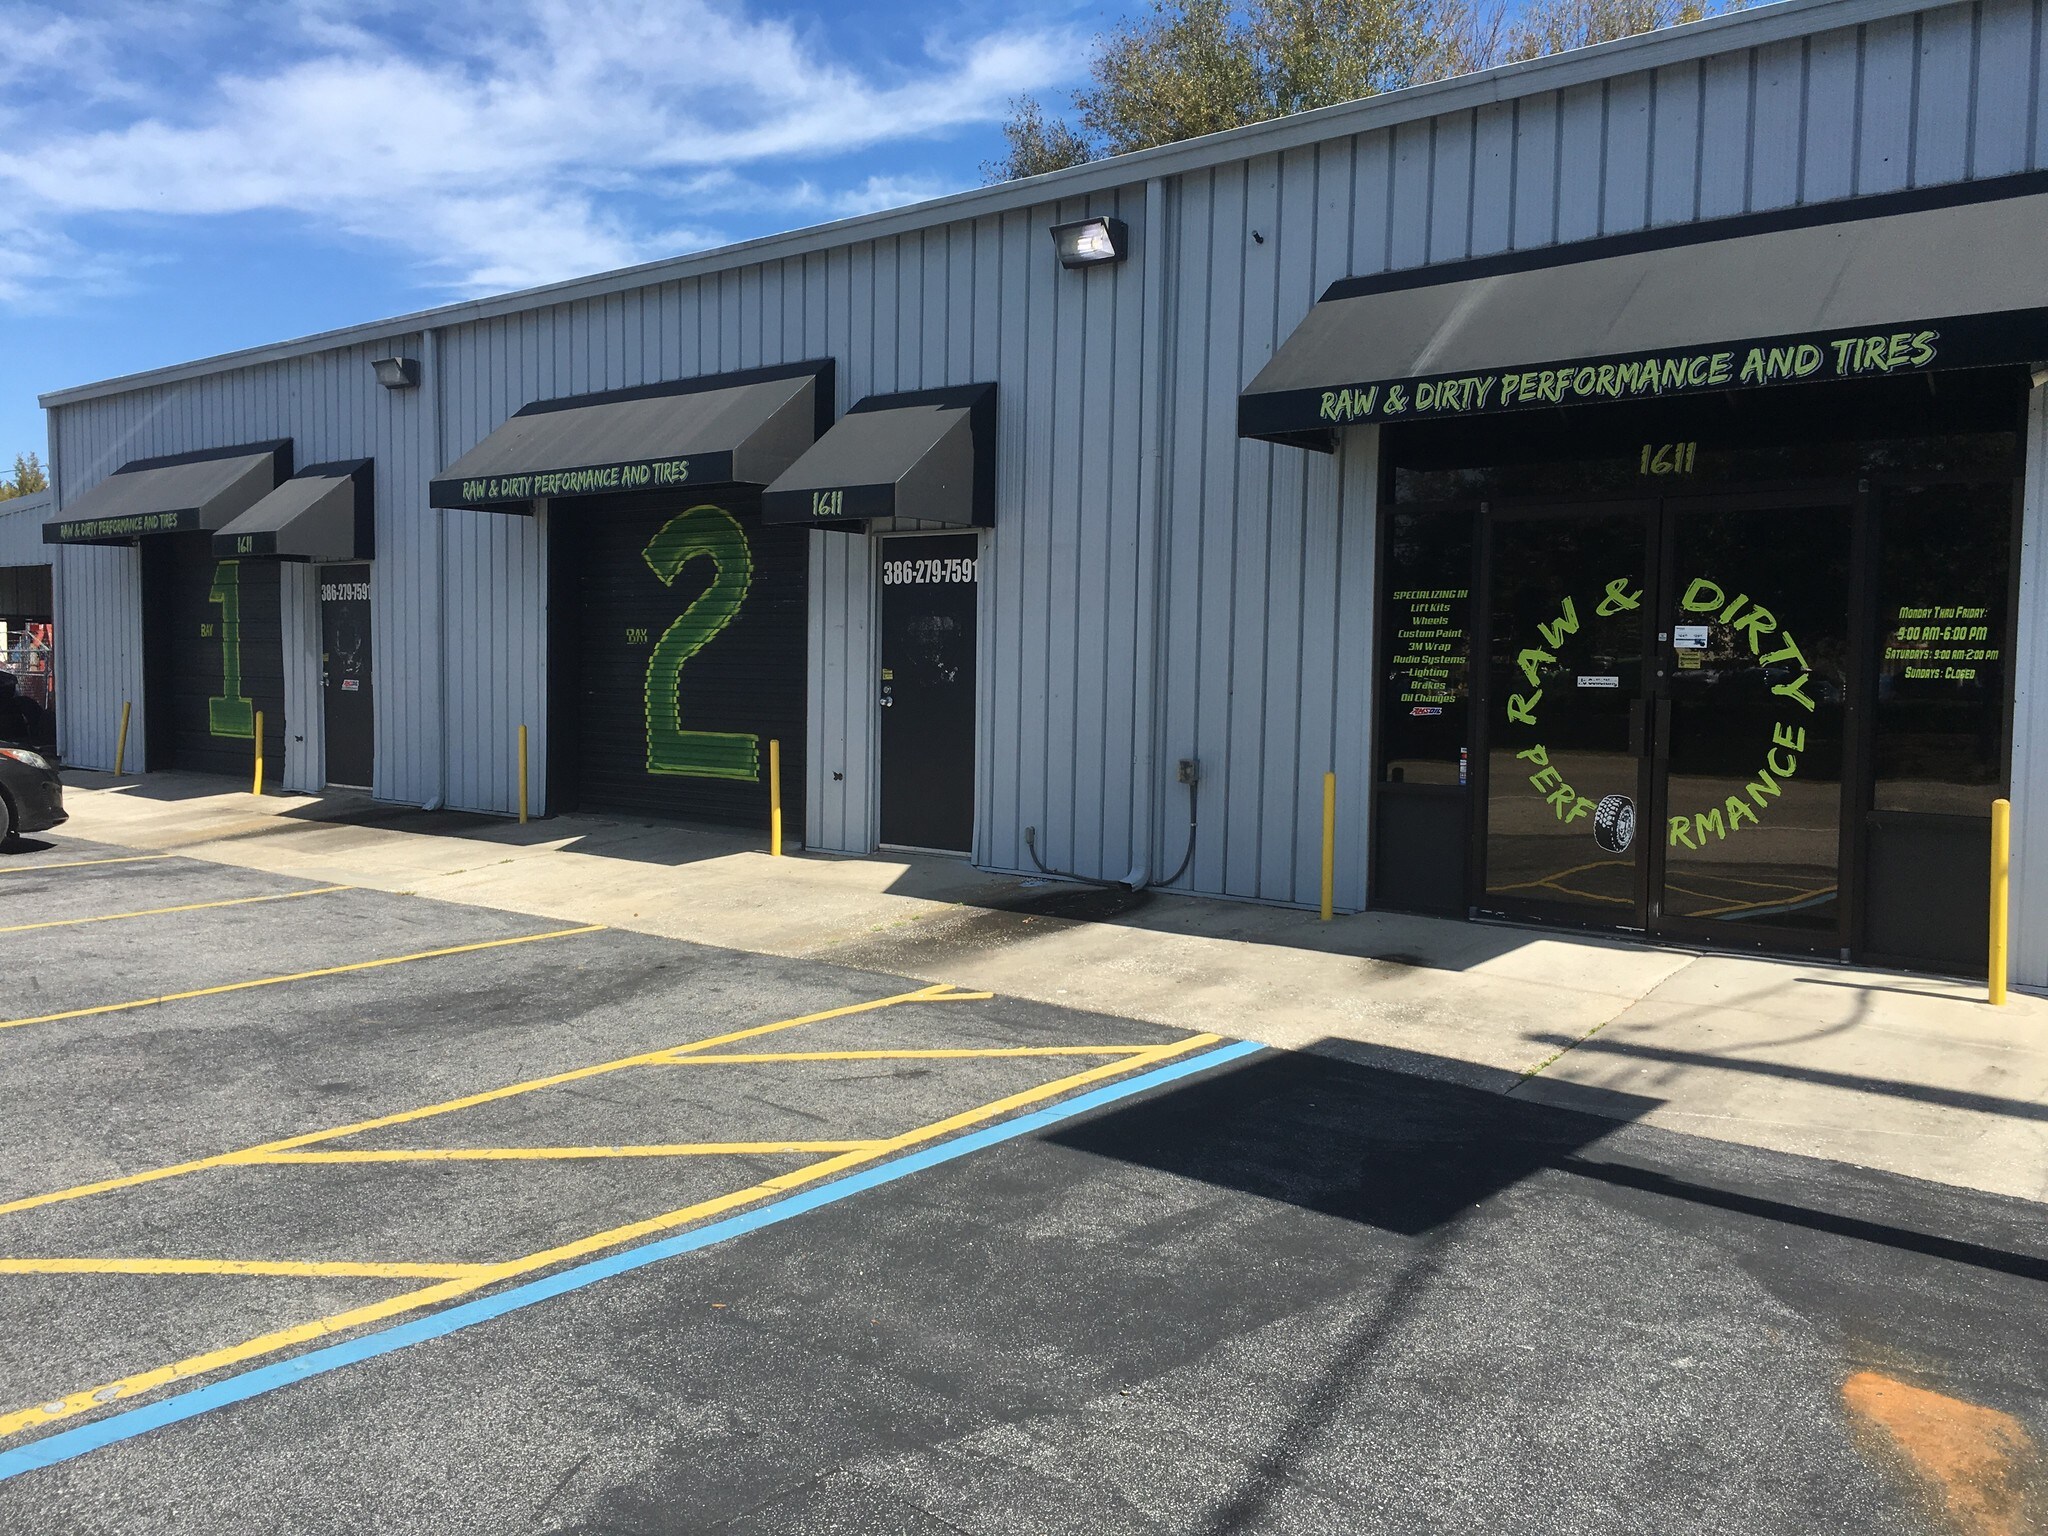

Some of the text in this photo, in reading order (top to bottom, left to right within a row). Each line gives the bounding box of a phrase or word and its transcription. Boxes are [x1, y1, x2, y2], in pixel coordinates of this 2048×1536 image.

[1319, 329, 1941, 421] RAW & DIRTY PERFORMANCE AND TIRES
[1639, 442, 1697, 476] 1611
[462, 460, 690, 501] RAW & DIRTY PERFORMANCE AND TIRES
[812, 490, 843, 516] 1611
[60, 524, 74, 539] RAW
[81, 521, 98, 537] DIRTY
[98, 516, 143, 535] PERFORMANCE
[144, 514, 158, 531] AND
[159, 513, 178, 529] TIRES
[237, 535, 253, 553] 1611
[883, 558, 978, 585] 386-279-7591
[321, 583, 371, 601] 386-279-7591
[1393, 590, 1468, 600] SPECIALIZING IN
[1410, 603, 1451, 612] Lift Kits
[1412, 616, 1449, 625] Wheels
[200, 623, 213, 637] BAY
[625, 628, 648, 645] BAY
[1398, 629, 1463, 638] Custom Paint
[1897, 626, 1921, 641] 9:00
[1968, 626, 1988, 640] PM
[208, 559, 254, 738] 1
[641, 504, 758, 782] 2
[1408, 642, 1451, 652] 3M Wrap
[1507, 577, 1815, 725] RAW & DIRTY
[1392, 655, 1466, 665] Audio Systems
[1408, 668, 1449, 678] Lighting
[1411, 681, 1446, 690] Brakes
[1400, 693, 1456, 704] Oil Changes
